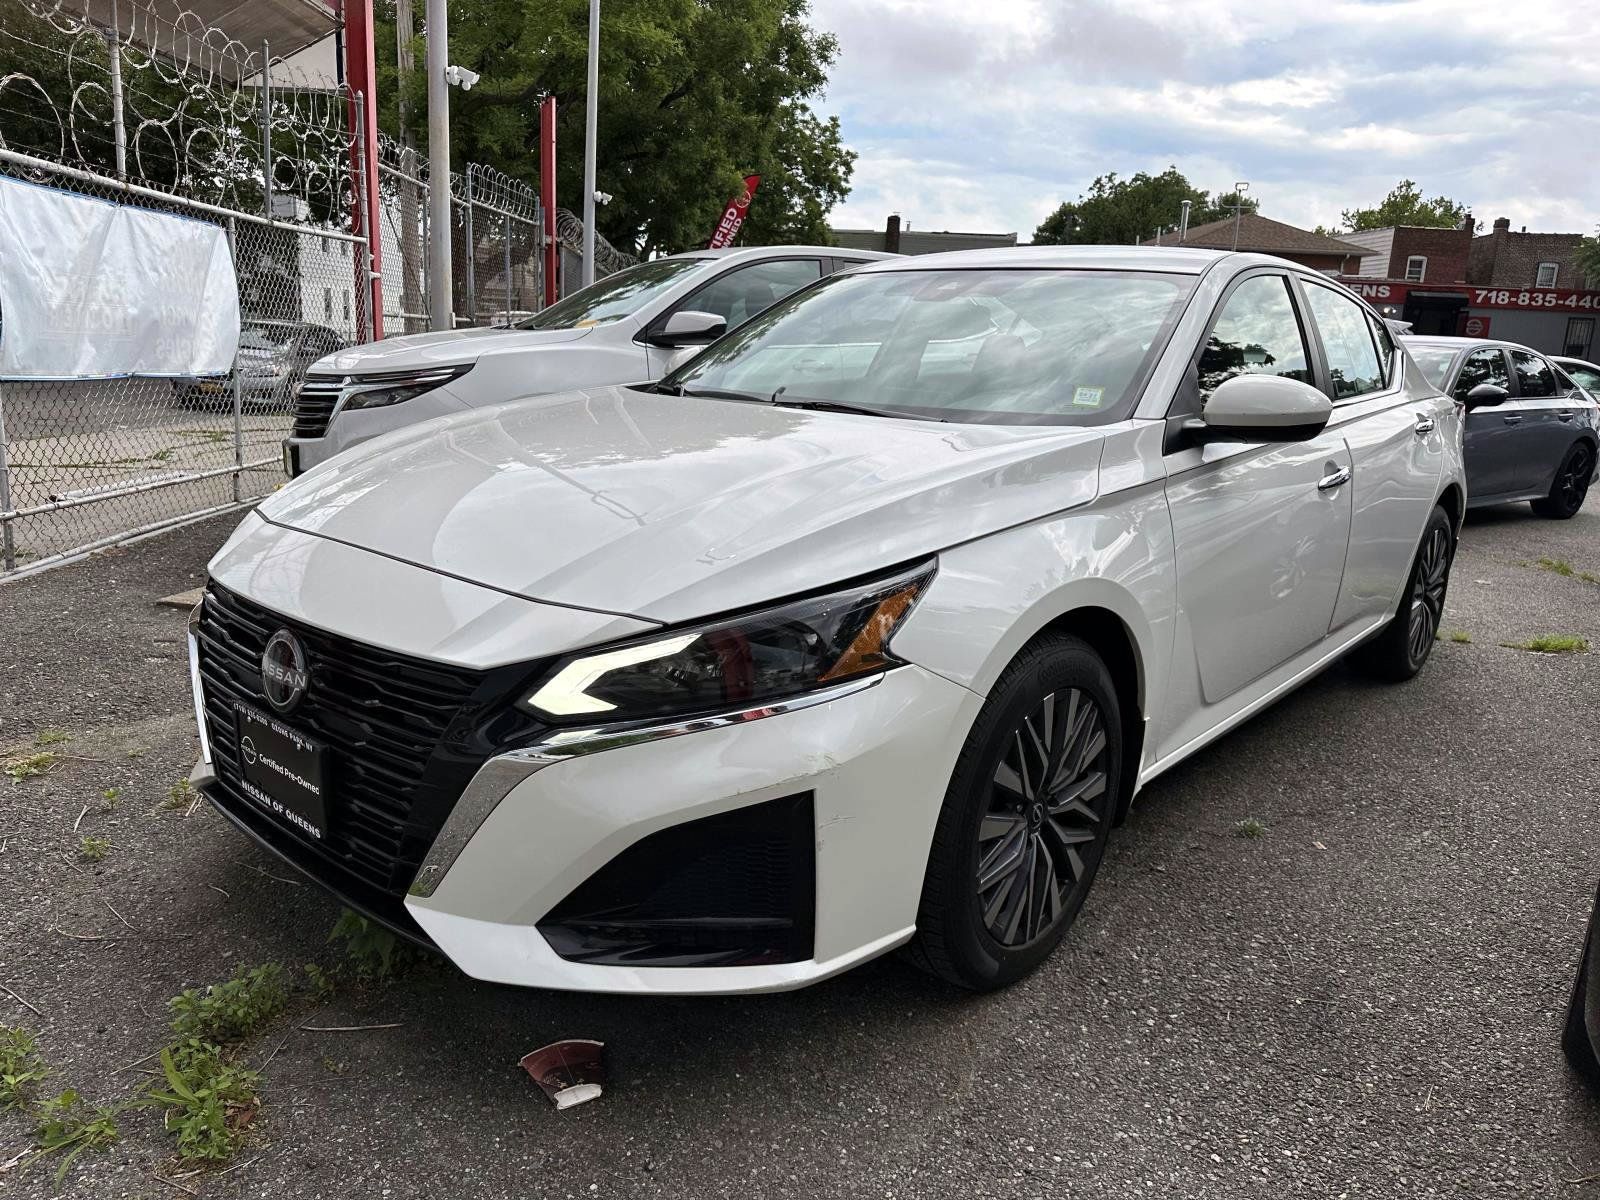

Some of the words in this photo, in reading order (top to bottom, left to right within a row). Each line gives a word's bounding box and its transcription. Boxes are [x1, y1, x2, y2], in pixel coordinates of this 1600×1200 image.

[1343, 283, 1391, 298] ENS
[259, 753, 284, 775] Certified
[284, 768, 320, 795] Pre-Owned
[241, 780, 272, 806] NISSAN
[272, 801, 284, 814] OF
[285, 809, 321, 839] QUEENS
